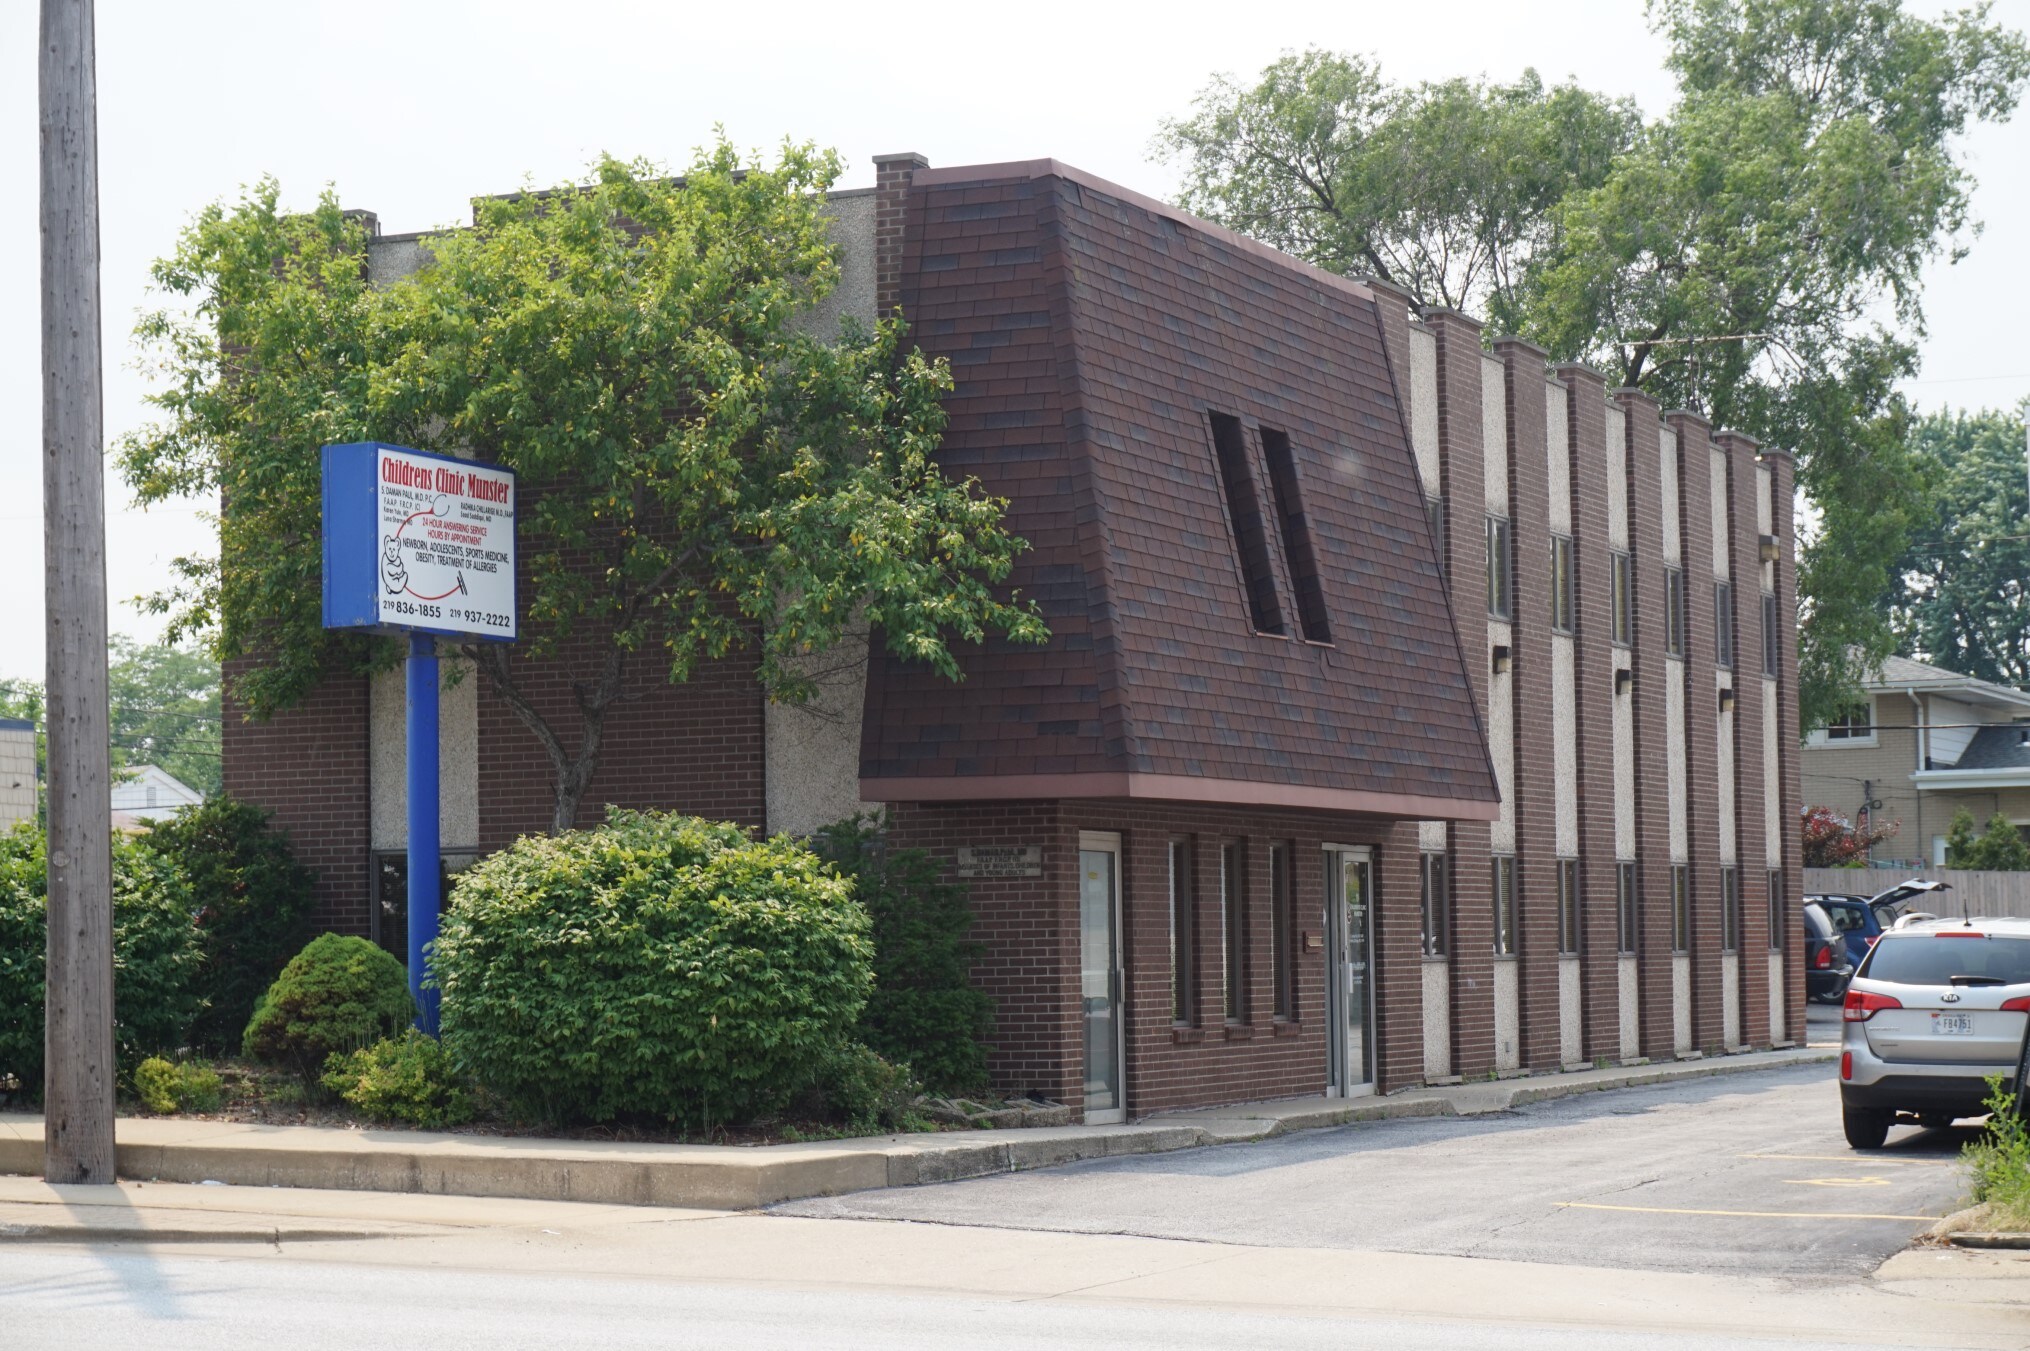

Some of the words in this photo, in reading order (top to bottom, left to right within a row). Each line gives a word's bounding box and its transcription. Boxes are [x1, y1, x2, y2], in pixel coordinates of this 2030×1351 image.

[382, 457, 433, 490] Childrens
[435, 467, 465, 496] Clinic
[467, 473, 510, 504] Munster
[386, 486, 401, 497] DAMAN
[422, 517, 429, 527] 24
[429, 519, 443, 530] HOUR
[443, 521, 469, 534] ANSWERING
[470, 525, 487, 537] SERVICE
[427, 529, 444, 540] HOURS
[444, 532, 450, 541] BY
[450, 533, 482, 546] APPOINTMENT
[402, 538, 428, 552] NEWBORN,
[430, 542, 465, 558] ADOLESCENTS,
[465, 547, 484, 560] SPORTS
[484, 551, 510, 565] MEDICINE,
[415, 552, 436, 565] OBESITY,
[437, 555, 465, 569] TREATMENT
[465, 560, 472, 569] OF
[472, 561, 498, 573] ALLERGIES
[383, 600, 395, 610] 219
[396, 601, 441, 618] 836-1855
[450, 609, 461, 618] 219
[464, 610, 510, 628] 937-2222
